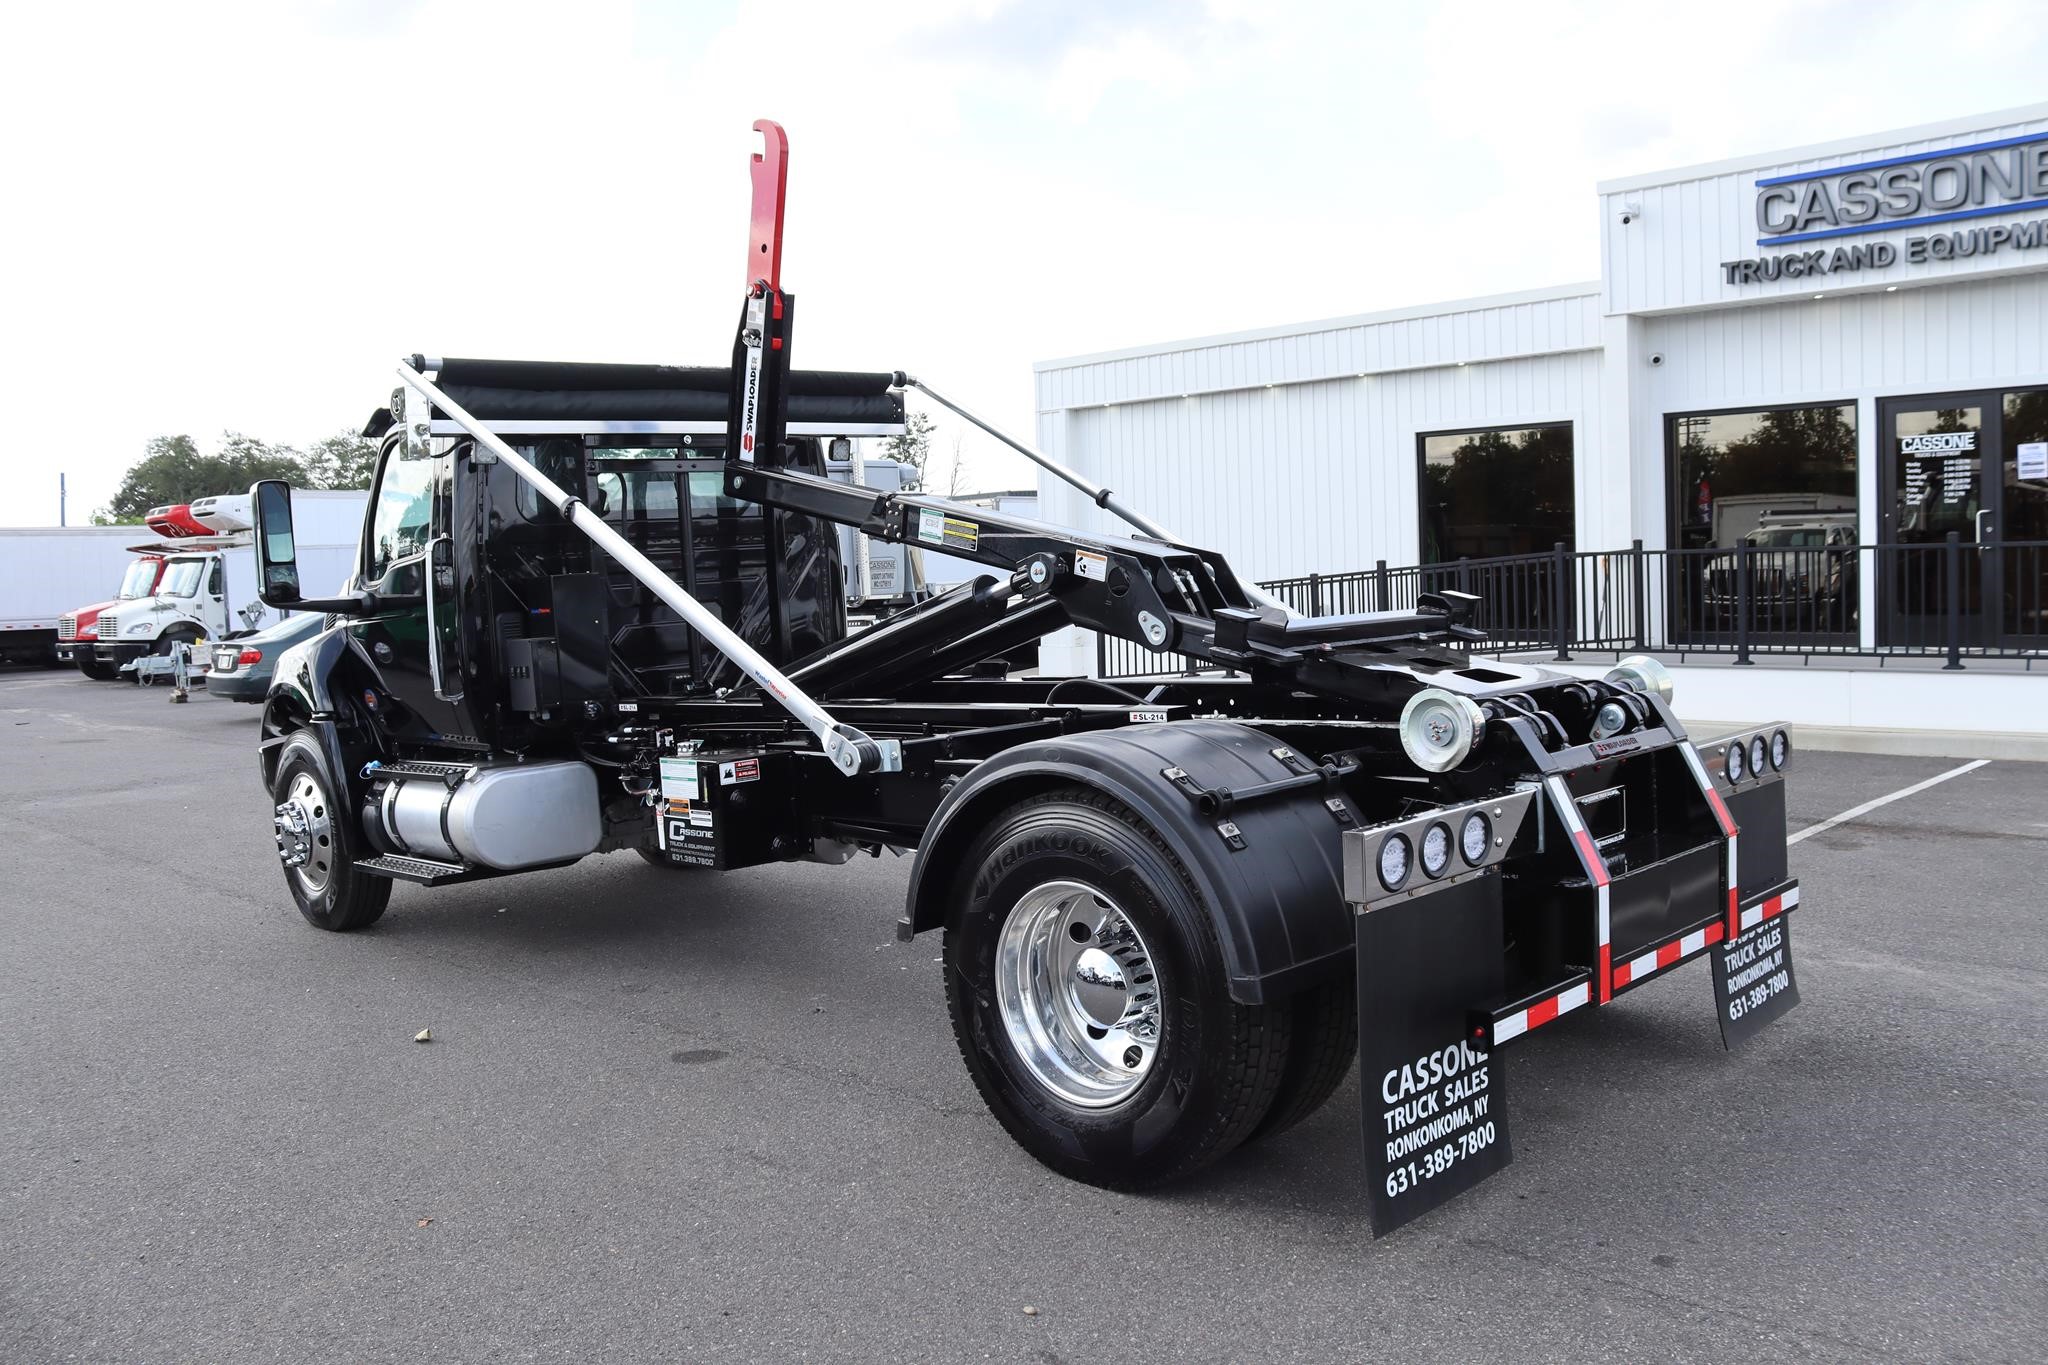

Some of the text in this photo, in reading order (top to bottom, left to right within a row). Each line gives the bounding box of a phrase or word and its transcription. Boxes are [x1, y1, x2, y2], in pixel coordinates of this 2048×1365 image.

[1756, 142, 2048, 234] CASSONE
[1721, 249, 1827, 285] TRUCK
[1827, 240, 1896, 272] AND
[747, 356, 758, 431] SWAPLOADER
[1901, 435, 1975, 451] CASSONE
[1138, 713, 1164, 721] SL-214
[1724, 944, 1756, 973] TRUCK
[1757, 928, 1782, 956] SALES
[1727, 949, 1783, 995] RONKONKOMA, NY
[1729, 970, 1789, 1021] 631-389-7800
[1384, 1066, 1489, 1134] TRUCK SALES
[1386, 1095, 1489, 1163] RONKONKOMA, NY
[1386, 1121, 1496, 1198] 631-389-7800
